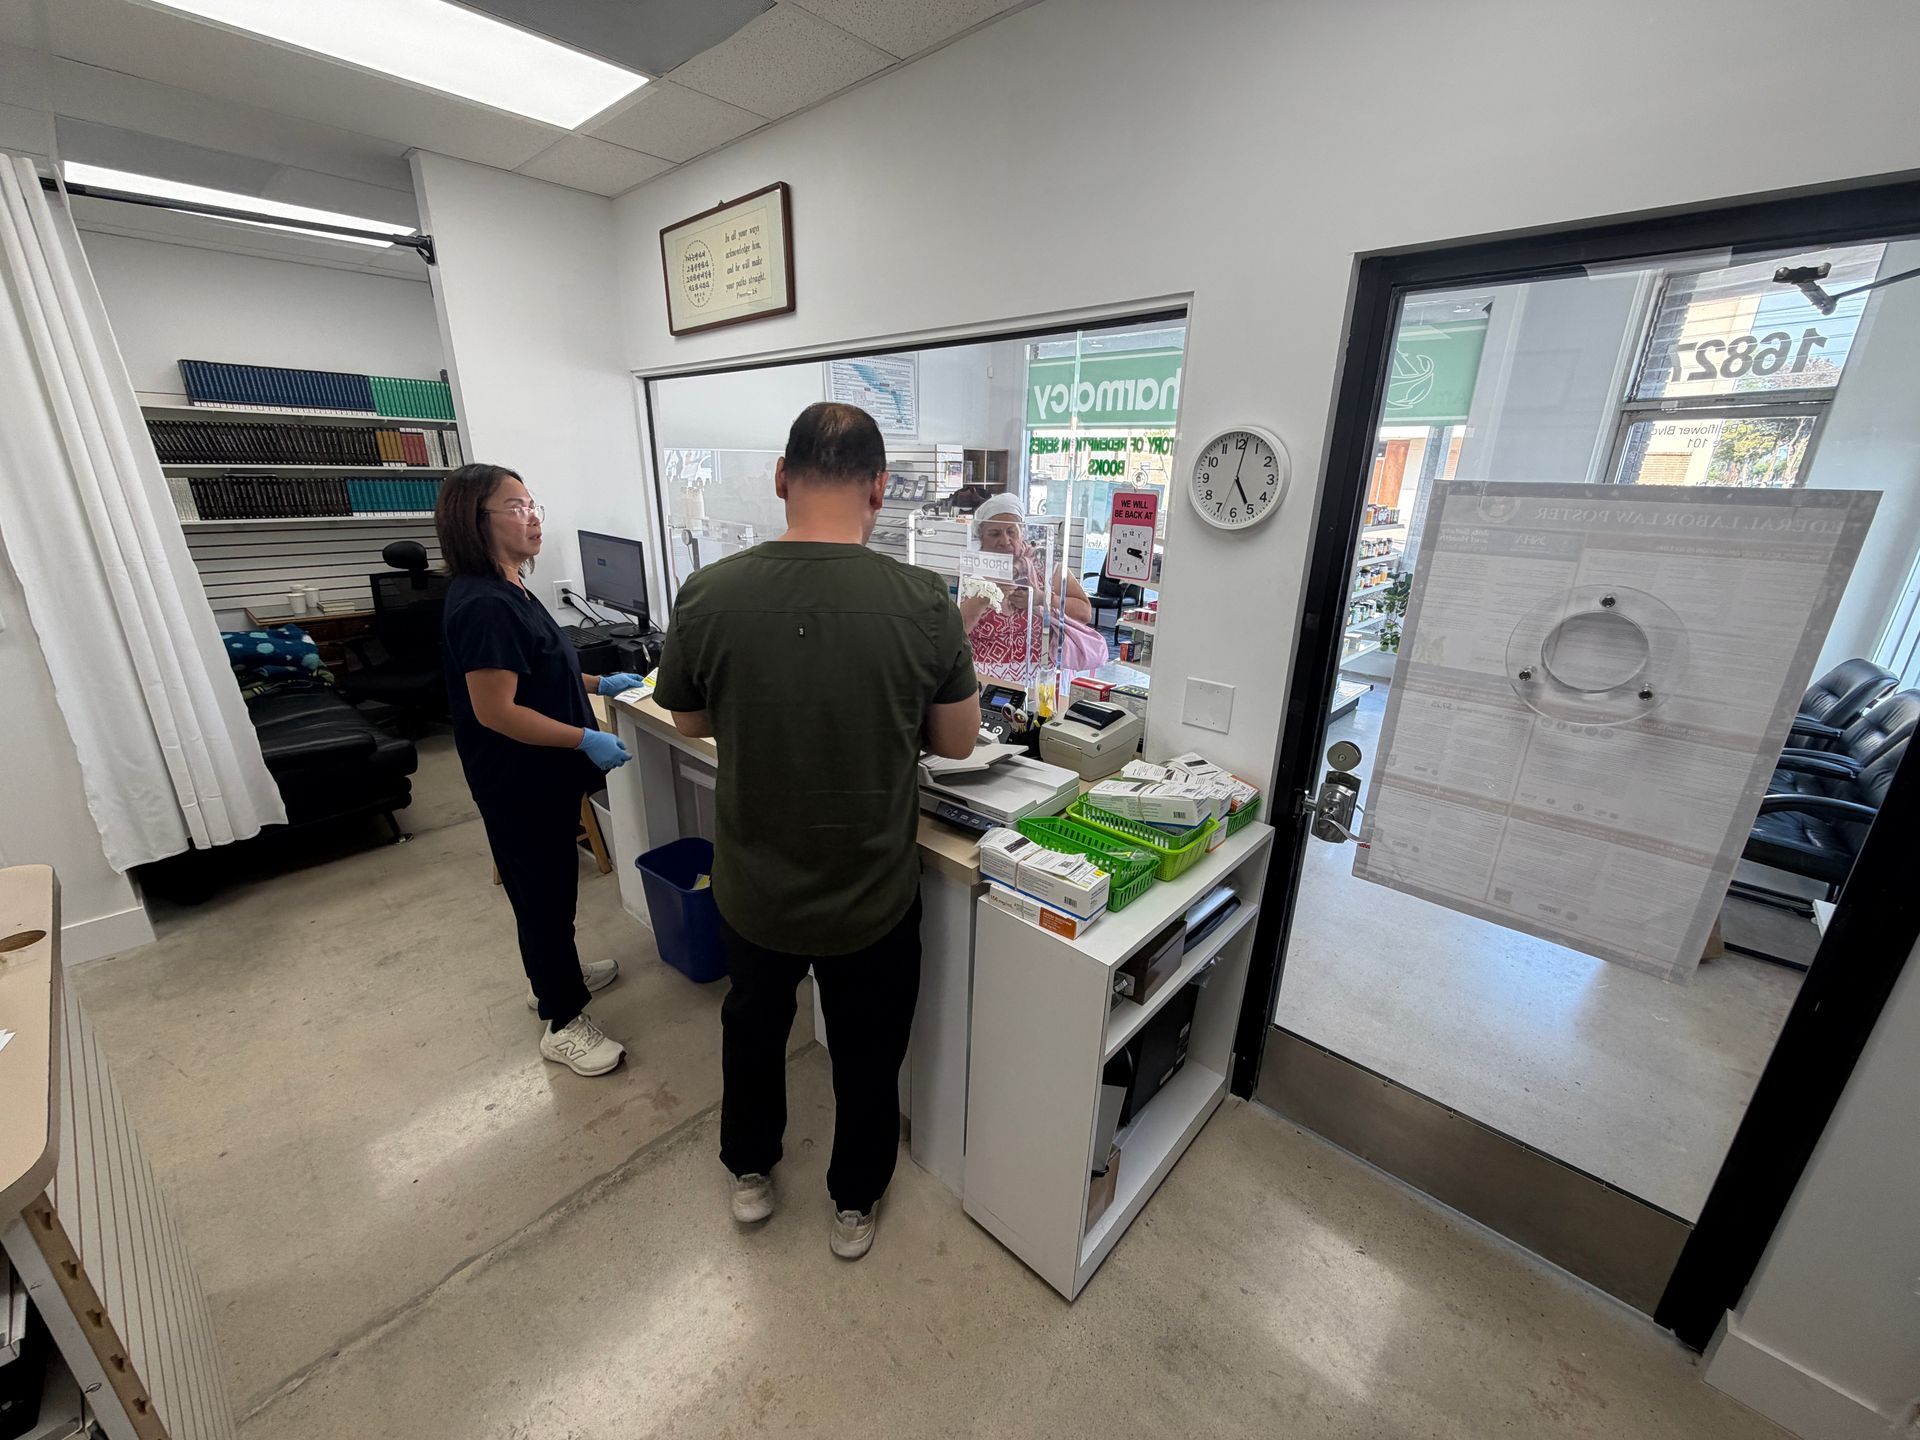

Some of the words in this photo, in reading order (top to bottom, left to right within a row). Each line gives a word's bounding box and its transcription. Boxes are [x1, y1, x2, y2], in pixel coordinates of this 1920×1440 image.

[1222, 443, 1228, 454] 11
[1235, 438, 1246, 450] 12
[1255, 443, 1259, 454] 1
[1208, 456, 1219, 468] 10
[1263, 456, 1272, 467] 2
[1202, 472, 1210, 483] 9
[1266, 474, 1275, 485] 3
[1205, 489, 1213, 500] 8
[1259, 491, 1268, 502] 4
[1121, 500, 1131, 508] WE
[1133, 501, 1148, 509] WILL
[1215, 502, 1223, 513] 7
[1246, 503, 1254, 514] 5
[1114, 510, 1123, 518] BE
[1125, 510, 1143, 519] BACK
[1144, 512, 1153, 520] AT
[1229, 507, 1237, 518] 6
